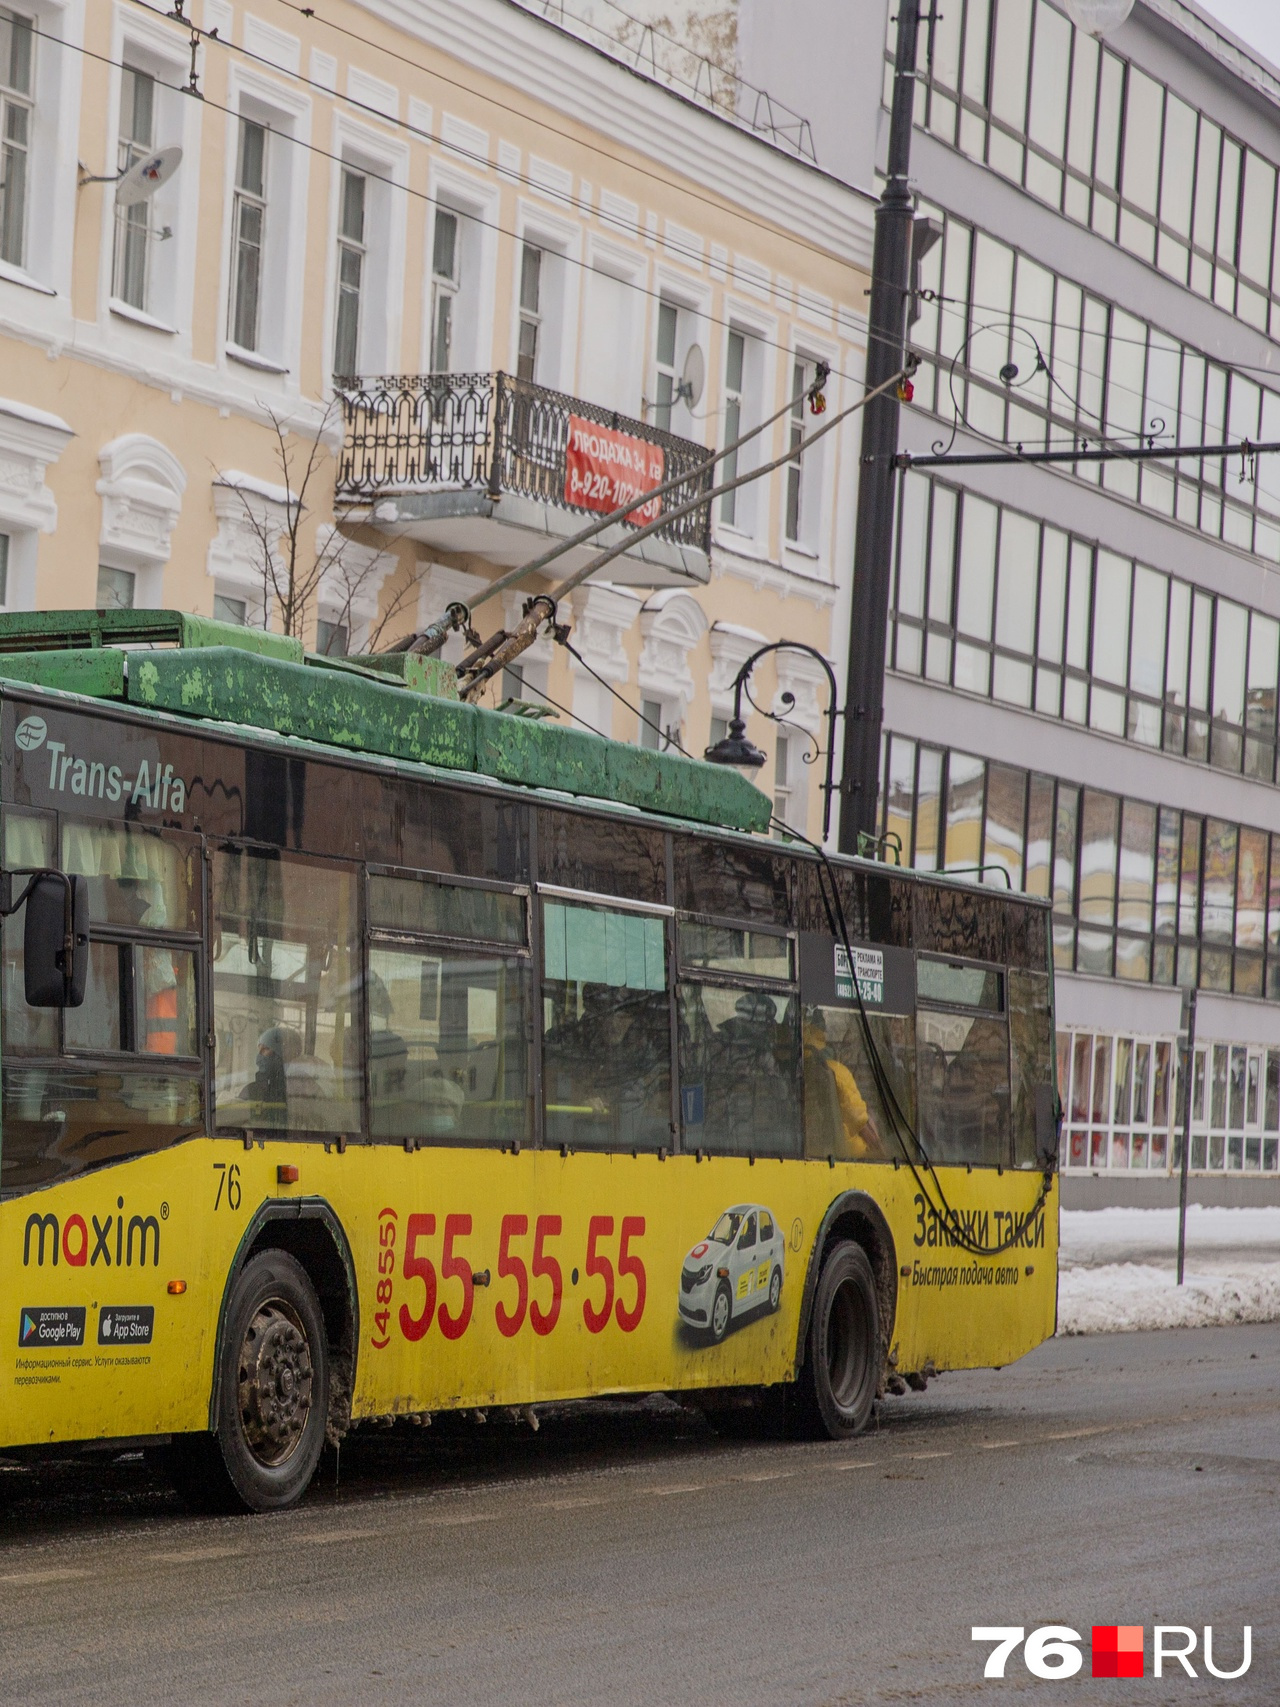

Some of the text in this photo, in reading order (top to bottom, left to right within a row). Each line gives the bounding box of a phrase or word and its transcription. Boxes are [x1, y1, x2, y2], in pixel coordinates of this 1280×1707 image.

[573, 429, 633, 469] ПРОДАЖА
[46, 740, 186, 814] Trans-Alfa
[857, 952, 876, 965] РЕКЛАМА
[877, 955, 882, 965] НА
[857, 966, 882, 980] ТРАНСПОРТЕ
[213, 1163, 242, 1212] 76
[913, 1192, 1045, 1249] Закажи такси
[371, 1207, 398, 1350] (4855)
[912, 1259, 1019, 1291] Быстрая подача авто
[114, 1313, 136, 1322] Загрузите
[38, 1323, 82, 1342] Google Play
[113, 1322, 150, 1340] App Store
[15, 1357, 71, 1371] Информационный
[94, 1355, 114, 1368] Услуги
[114, 1355, 152, 1366] оказываются
